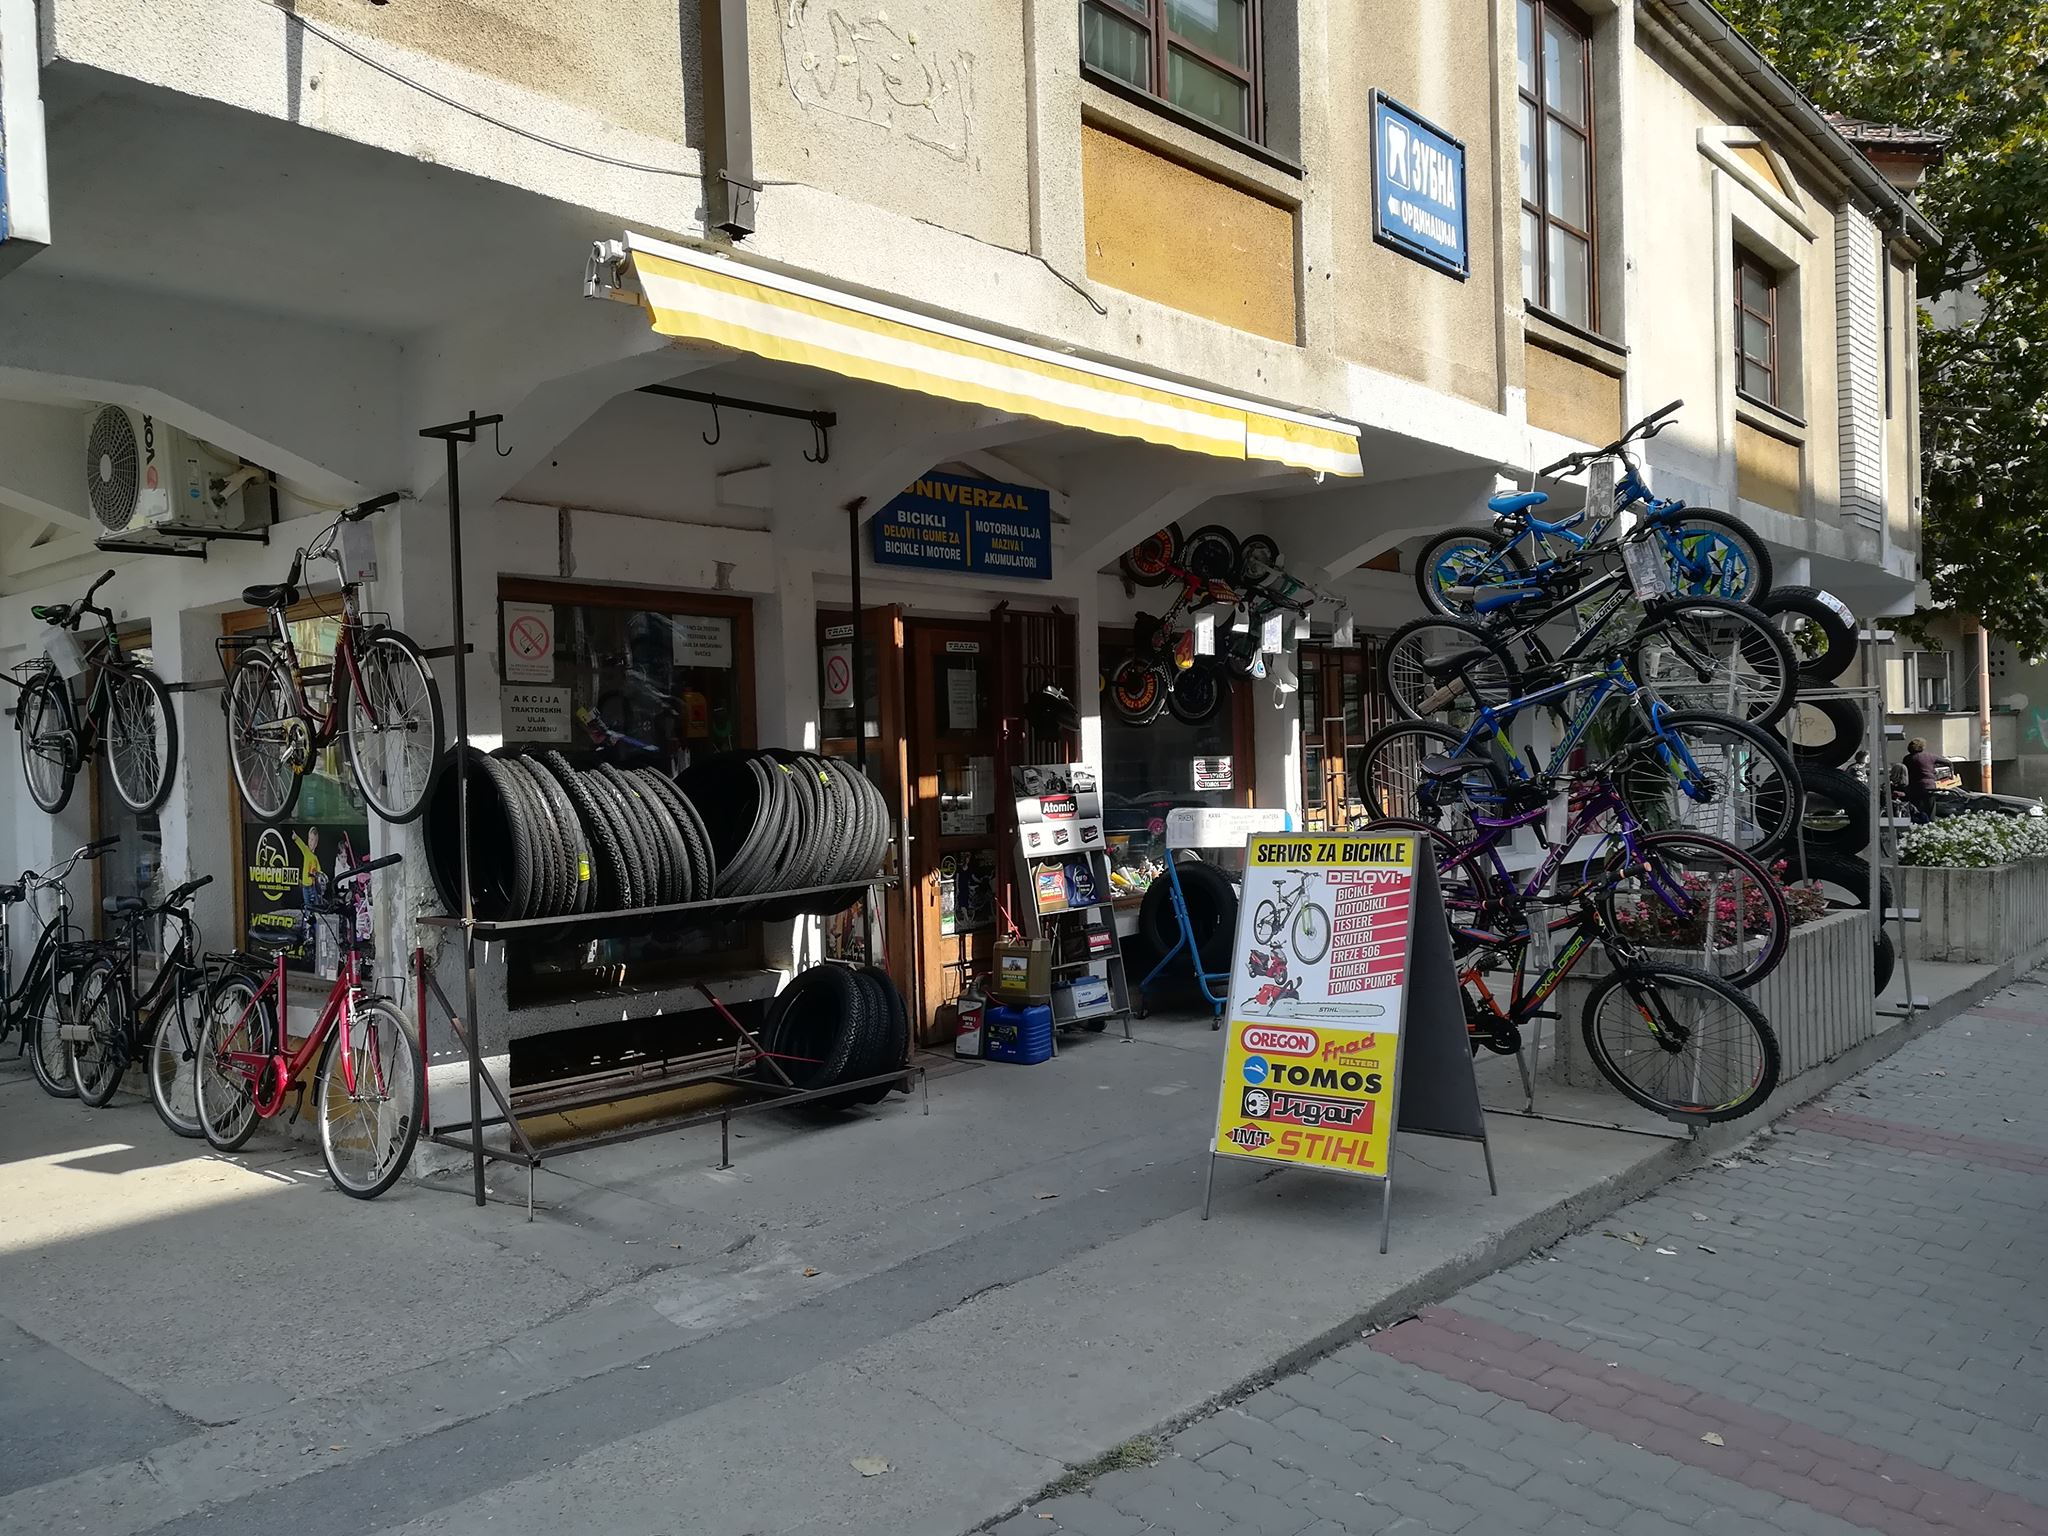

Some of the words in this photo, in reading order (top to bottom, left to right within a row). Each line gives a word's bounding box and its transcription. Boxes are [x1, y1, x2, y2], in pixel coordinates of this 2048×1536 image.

[1412, 138, 1456, 211] ЗУБНА
[1401, 200, 1457, 249] ОРДИНАЦИЈА
[897, 510, 946, 528] BICIKLI
[884, 524, 916, 540] DELOVI
[922, 530, 947, 544] GUME
[949, 533, 960, 545] ZA
[975, 520, 1019, 537] MOTORNA
[1020, 525, 1041, 539] ULJA
[885, 541, 919, 556] BICIKLE
[926, 546, 961, 561] MOTORE
[991, 538, 1019, 552] MAZIVA
[984, 552, 1037, 569] AKUMULATORI
[510, 706, 562, 714] TRAKTORSKIH
[516, 725, 527, 733] ZA
[527, 725, 558, 733] ZAMENU
[1043, 801, 1075, 814] Atomic
[1257, 843, 1312, 864] SERVIS
[1316, 843, 1337, 862] ZA
[1341, 843, 1406, 863] BICIKLE
[1534, 822, 1586, 887] VISITOR
[283, 868, 299, 884] BIKE
[1327, 870, 1403, 885] DELOVI:
[1337, 884, 1374, 900] BICIKLE
[1336, 897, 1388, 916] MOTOCIKLI
[1335, 915, 1374, 932] TESTERE
[1333, 930, 1373, 947] SKUTERI
[1332, 948, 1360, 964] FREZE
[1361, 946, 1380, 959] 506
[1331, 963, 1369, 979] TRIMERI
[1535, 934, 1585, 998] EXPLORER
[1330, 977, 1362, 995] TOMOS
[1363, 973, 1397, 991] PUMPE
[1249, 1031, 1310, 1051] OREGON
[1340, 1058, 1379, 1068] FILTERI
[1270, 1064, 1382, 1094] TOMOS
[1273, 1092, 1366, 1125] Tigar
[1231, 1127, 1270, 1148] IMT
[1277, 1130, 1375, 1167] STIHL
